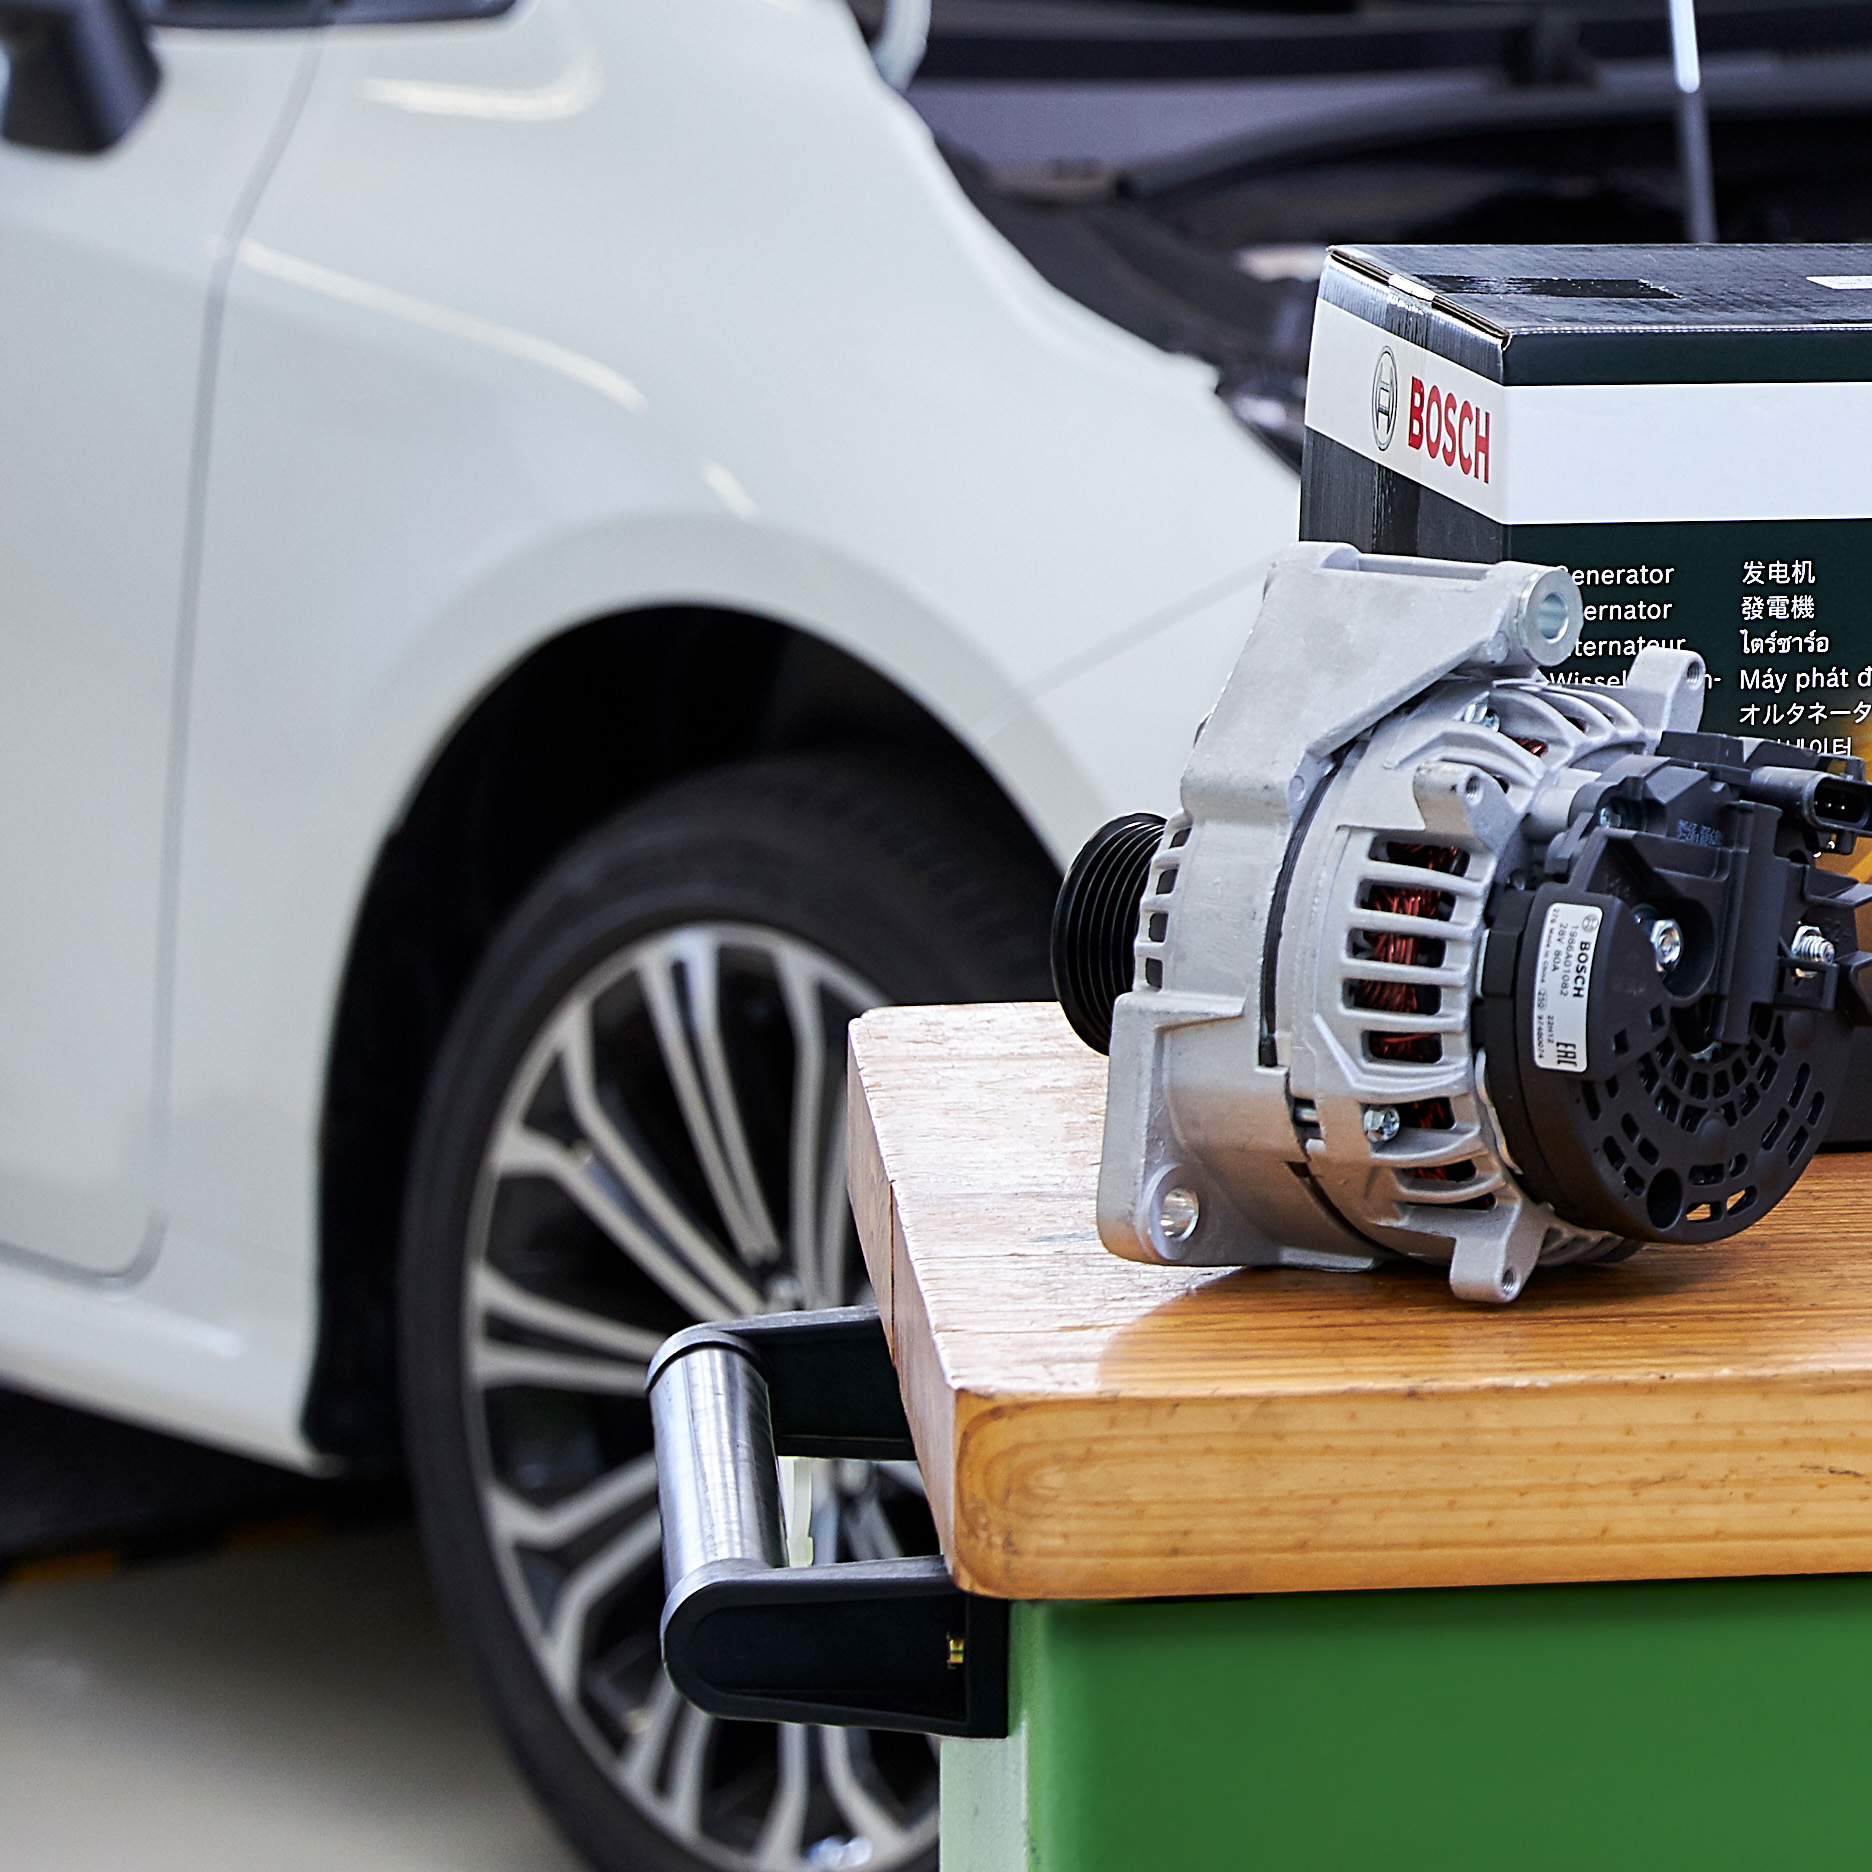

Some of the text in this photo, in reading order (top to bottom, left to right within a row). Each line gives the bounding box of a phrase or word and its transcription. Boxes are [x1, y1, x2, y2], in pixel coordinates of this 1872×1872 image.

[1408, 376, 1490, 484] BOSCH
[1557, 565, 1675, 585] enerator
[1742, 560, 1816, 585] 发电机
[1584, 600, 1673, 621] ernator
[1741, 595, 1815, 620] 發電機
[1740, 668, 1788, 693] Máy
[1796, 667, 1850, 693] phát
[1572, 941, 1592, 999] BOSCH
